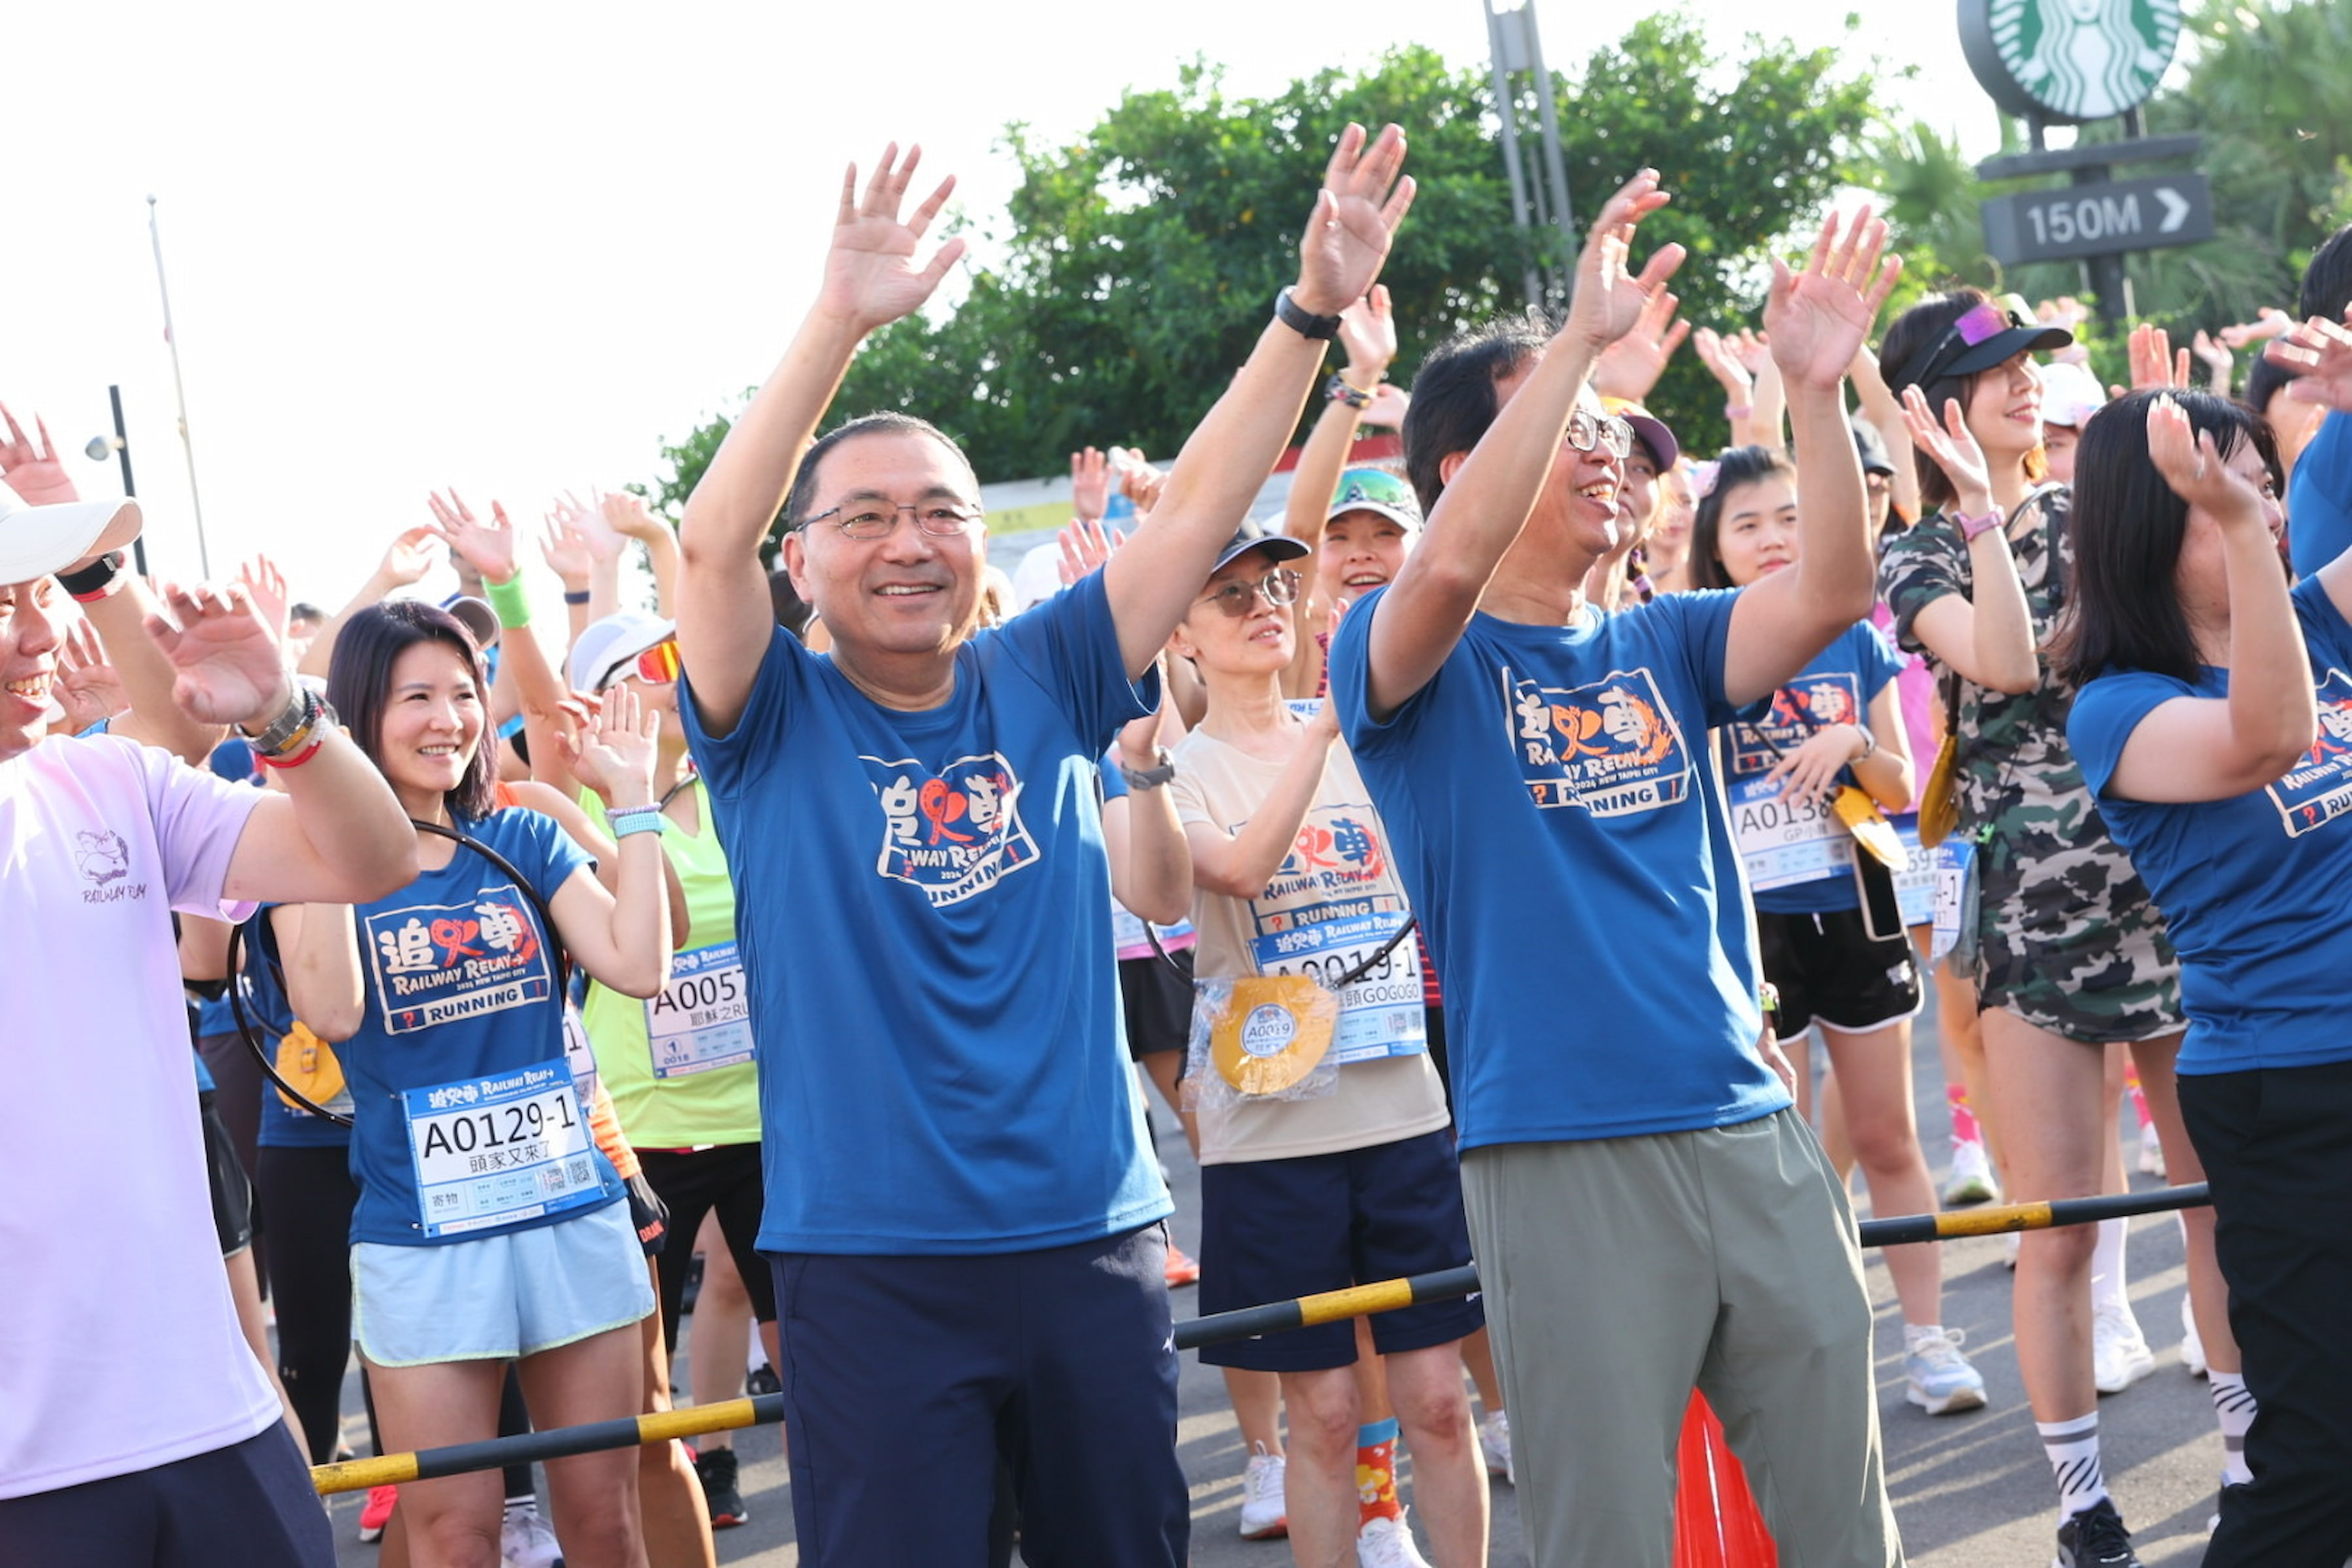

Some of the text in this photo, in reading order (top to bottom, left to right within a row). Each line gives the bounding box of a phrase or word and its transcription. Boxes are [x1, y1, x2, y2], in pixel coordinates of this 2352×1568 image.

[2027, 194, 2142, 245] 150M
[1584, 749, 1641, 778] RELAY
[1619, 771, 1642, 782] TAIPEI
[1643, 766, 1659, 777] CITY
[2281, 762, 2341, 790] RAILWAY
[1563, 787, 1654, 813] RNING
[1320, 871, 1362, 889] RELAY
[82, 885, 125, 904] RAILWAY
[1324, 920, 1371, 938] RAILWAY
[393, 954, 512, 996] RAILWAY RELAY
[429, 988, 518, 1022] RUNNING
[481, 1075, 523, 1096] RAILWAY
[424, 1094, 576, 1158] A0129-1
[468, 1140, 550, 1173] 頭家又來了
